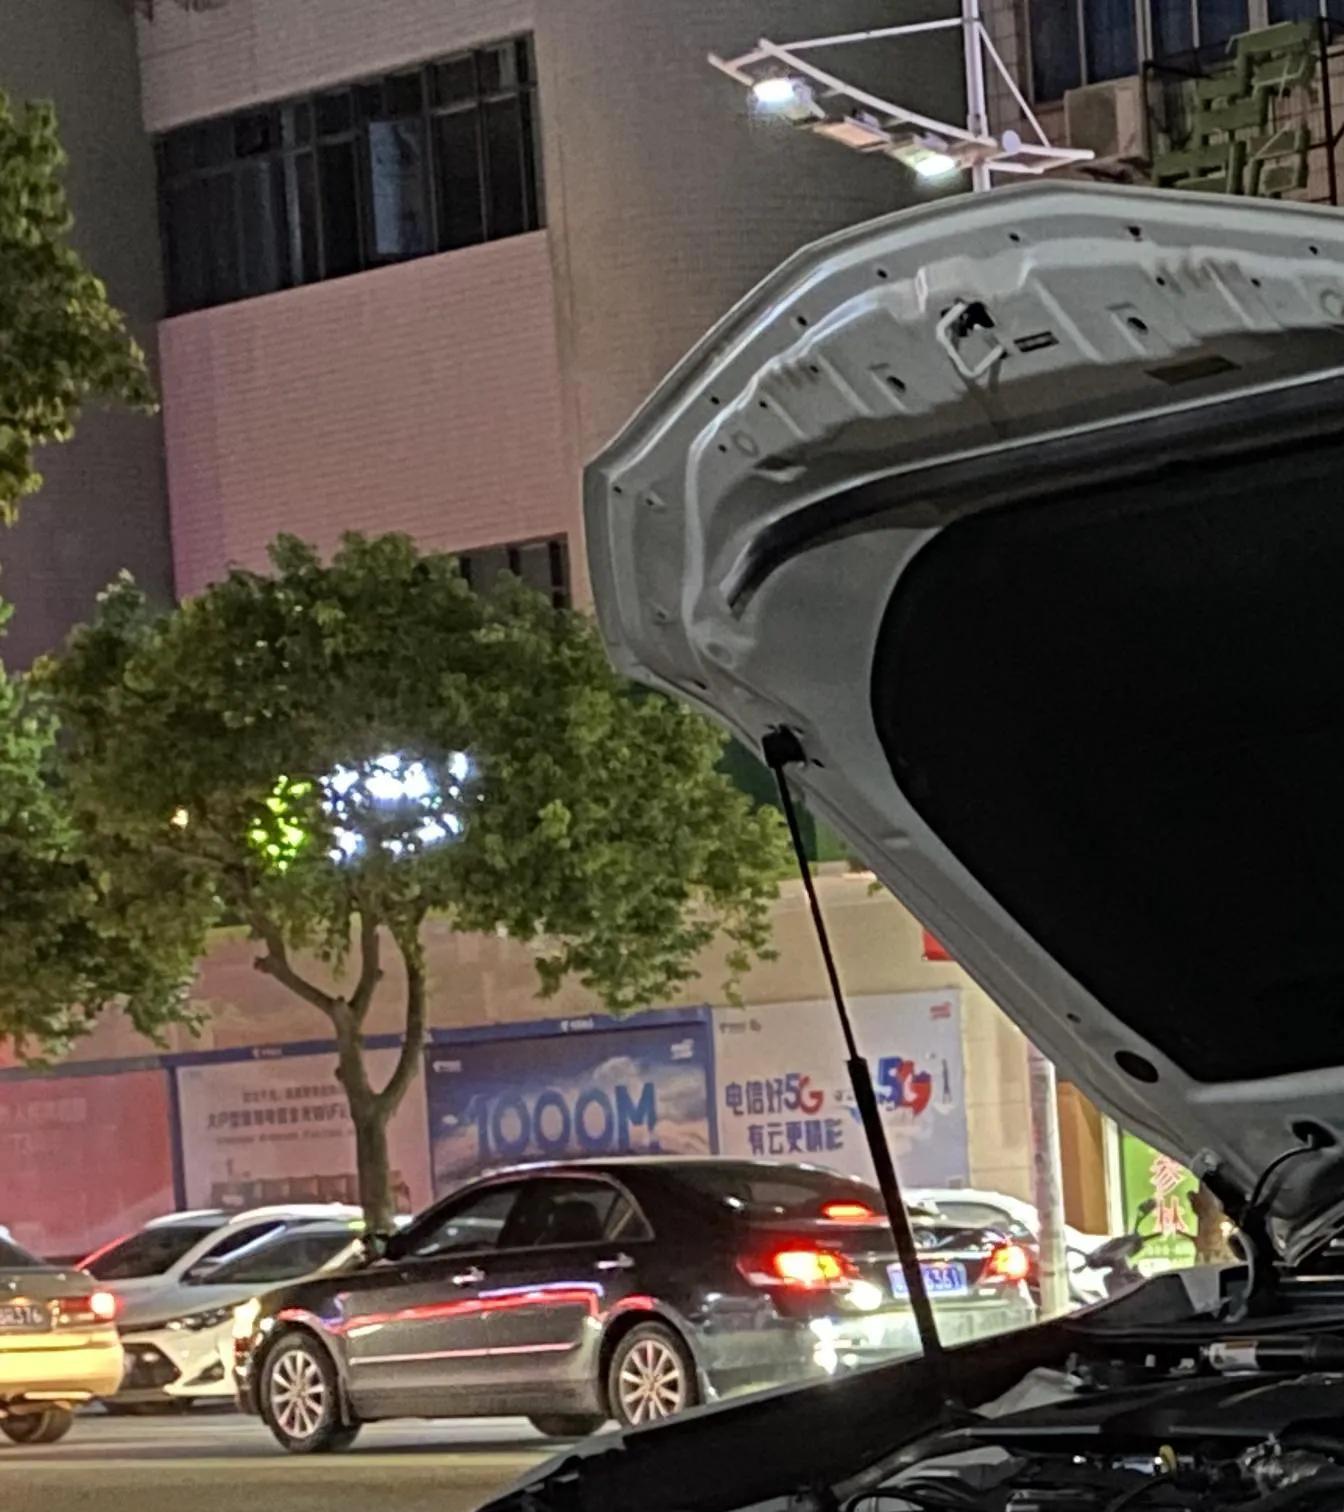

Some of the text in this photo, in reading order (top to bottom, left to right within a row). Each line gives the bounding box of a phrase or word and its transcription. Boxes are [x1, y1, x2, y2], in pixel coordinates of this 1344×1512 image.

[466, 1082, 660, 1160] 1000M
[725, 1072, 824, 1117] 电信好5G
